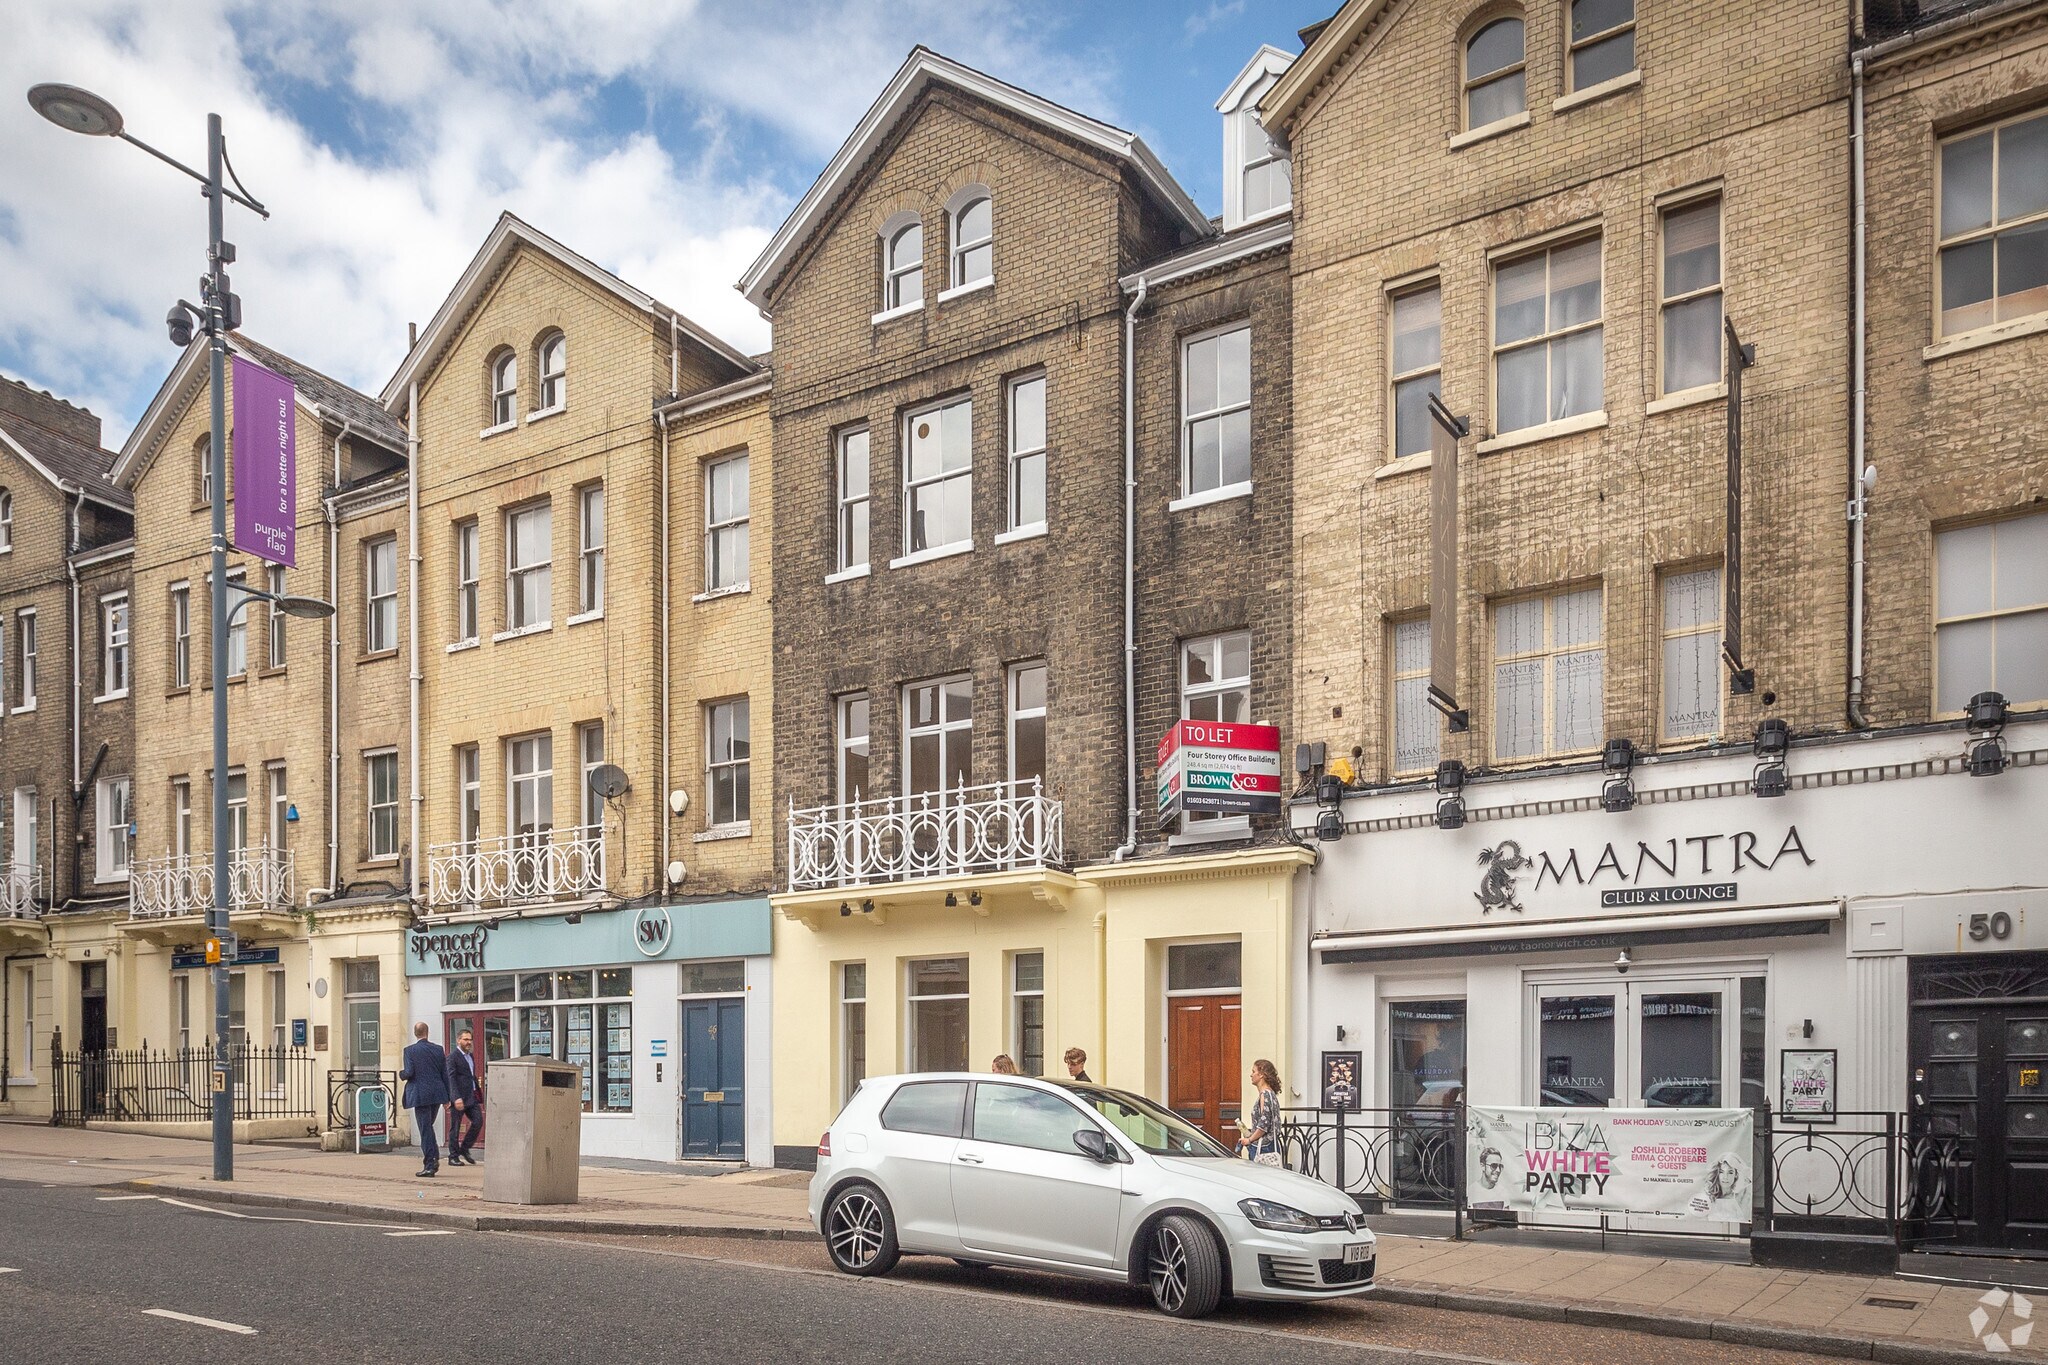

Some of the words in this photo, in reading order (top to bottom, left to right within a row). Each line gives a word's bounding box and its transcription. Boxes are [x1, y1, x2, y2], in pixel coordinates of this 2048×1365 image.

[278, 398, 287, 418] out
[277, 419, 289, 450] night
[278, 452, 287, 485] better
[281, 487, 287, 496] a
[278, 498, 287, 514] for
[254, 522, 287, 541] purple
[266, 534, 287, 556] flag
[1670, 571, 1717, 586] MANTRA
[1399, 623, 1431, 635] MANTR
[1556, 653, 1601, 667] MANTRA
[1499, 663, 1541, 676] MANTRA
[1668, 709, 1717, 723] MANTRA
[1186, 726, 1205, 741] TO
[1208, 727, 1234, 743] LET
[1187, 751, 1203, 759] Four
[1204, 752, 1226, 762] Storey
[1227, 753, 1248, 762] Office
[1248, 755, 1276, 765] Building
[1398, 746, 1438, 758] MANTRA
[1534, 824, 1817, 891] MANTRA
[1603, 890, 1645, 905] CLUB
[1649, 889, 1660, 902] &
[1664, 885, 1736, 902] LOUNGE
[640, 918, 667, 944] SW
[1968, 911, 2011, 942] 50
[411, 931, 480, 961] spencer
[437, 938, 487, 970] ward
[362, 972, 375, 984] 44
[361, 1031, 376, 1040] THB
[1551, 1076, 1606, 1088] MANTRA
[1652, 1076, 1710, 1088] MANTRA
[1792, 1069, 1825, 1081] IBIZA
[1792, 1080, 1826, 1088] WHITE
[1792, 1087, 1826, 1096] PARTY
[1709, 1120, 1739, 1128] AUGUST
[1525, 1122, 1609, 1151] IBIZA
[1631, 1146, 1666, 1155] JOSHUA
[1668, 1146, 1707, 1156] ROBERTS
[1525, 1150, 1610, 1173] WHITE
[1631, 1154, 1656, 1162] EMMA
[1657, 1154, 1707, 1163] CONYBEARE
[1657, 1162, 1687, 1170] GUESTS
[1526, 1172, 1610, 1195] PARTY
